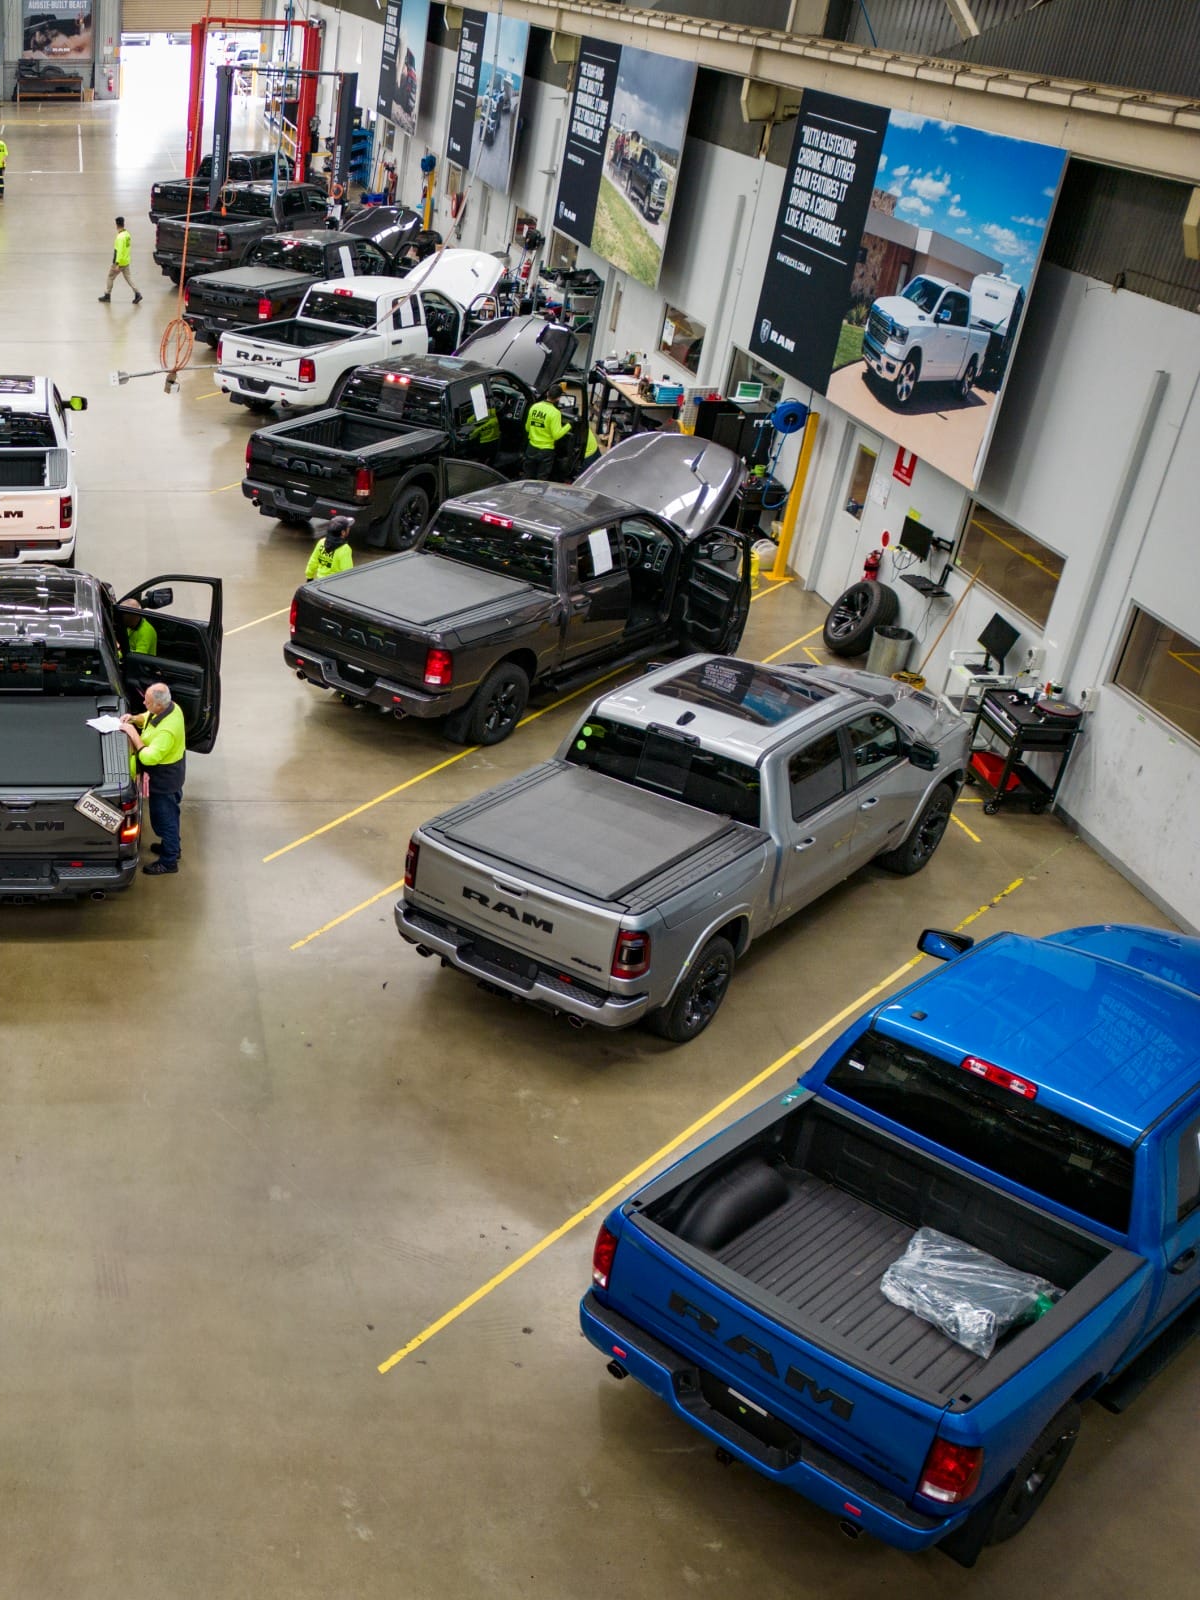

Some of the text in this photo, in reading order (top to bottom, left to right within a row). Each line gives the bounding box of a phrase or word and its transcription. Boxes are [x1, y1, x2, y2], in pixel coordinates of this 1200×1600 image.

[820, 132, 856, 158] GLISTENING
[798, 147, 855, 182] CHROME AND OTHER
[794, 167, 848, 201] GLAM FEATURES IT
[789, 187, 837, 220] DRAWS A CROWD
[785, 208, 800, 227] LIKE
[798, 213, 804, 229] A
[769, 329, 796, 353] RAM
[236, 349, 283, 368] RAM
[531, 409, 547, 419] RAM
[271, 453, 334, 479] RAM
[320, 617, 397, 656] RAM
[462, 886, 554, 934] RAM
[668, 1289, 855, 1421] RAM
